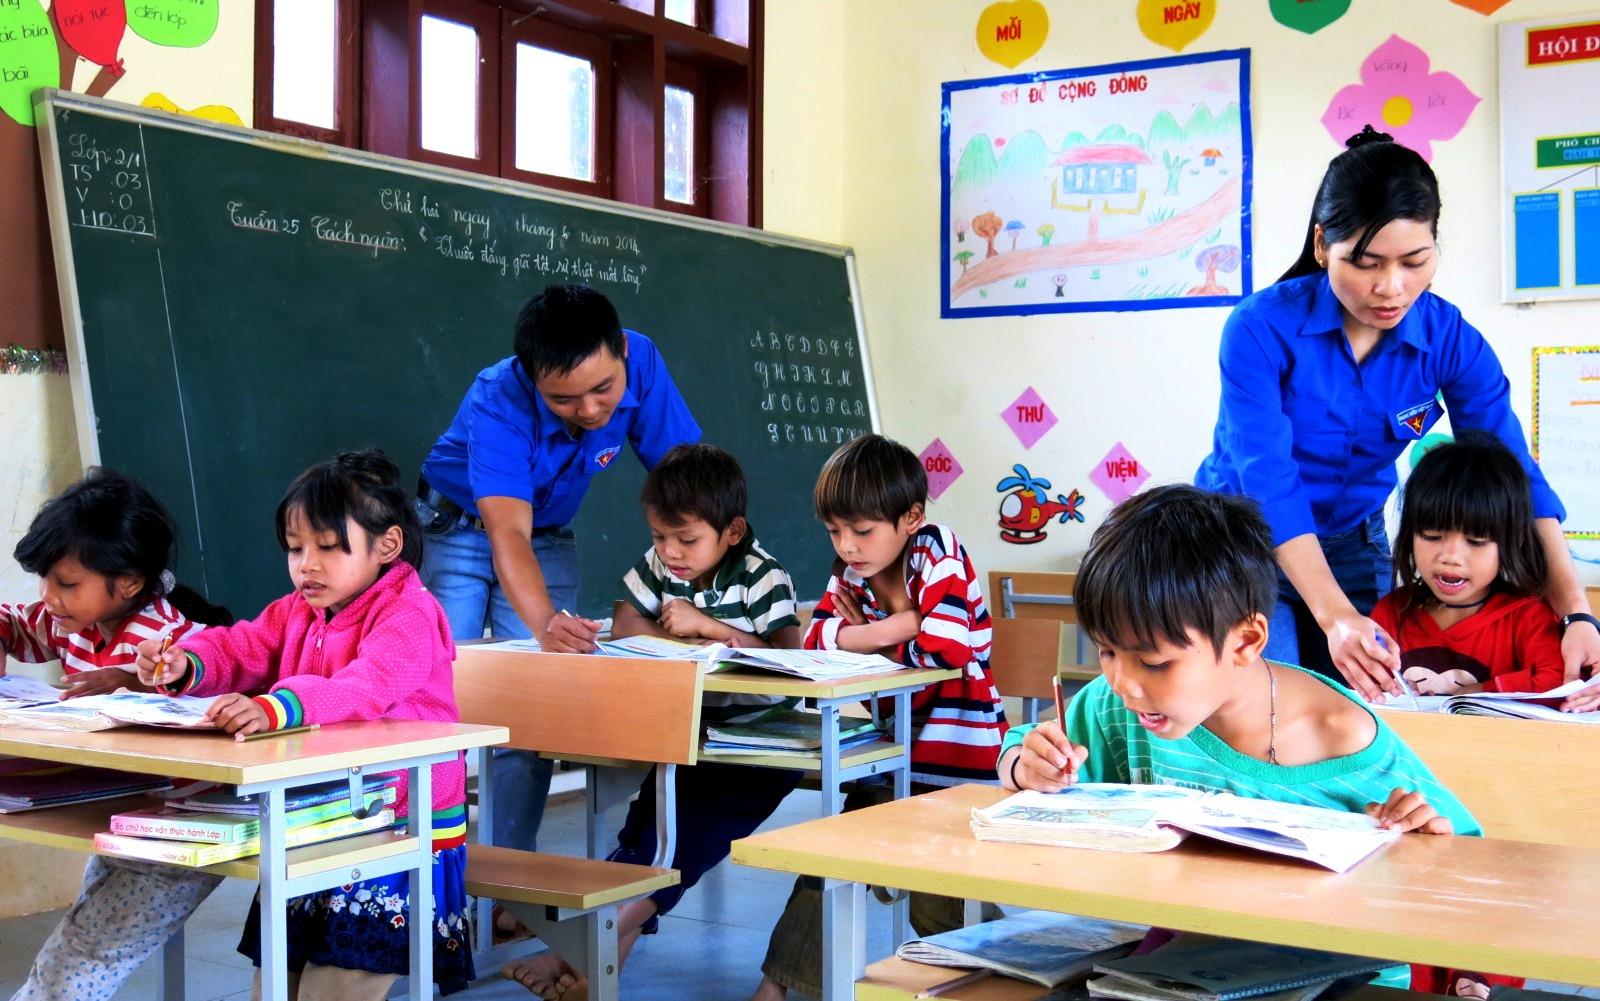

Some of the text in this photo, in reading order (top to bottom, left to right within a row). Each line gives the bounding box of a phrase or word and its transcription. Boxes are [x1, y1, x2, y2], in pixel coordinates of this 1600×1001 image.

[996, 15, 1022, 42] MỖI
[1538, 35, 1578, 58] HỘI
[1058, 80, 1097, 103] CỘNG
[1109, 72, 1148, 95] ĐỒNG
[114, 148, 140, 169] 2/1
[69, 163, 92, 181] TS
[76, 186, 89, 203] V
[420, 195, 440, 219] hai
[282, 219, 300, 235] 25
[1017, 403, 1045, 423] THƯ
[925, 452, 952, 473] GÓC
[1106, 459, 1138, 482] VIỆN
